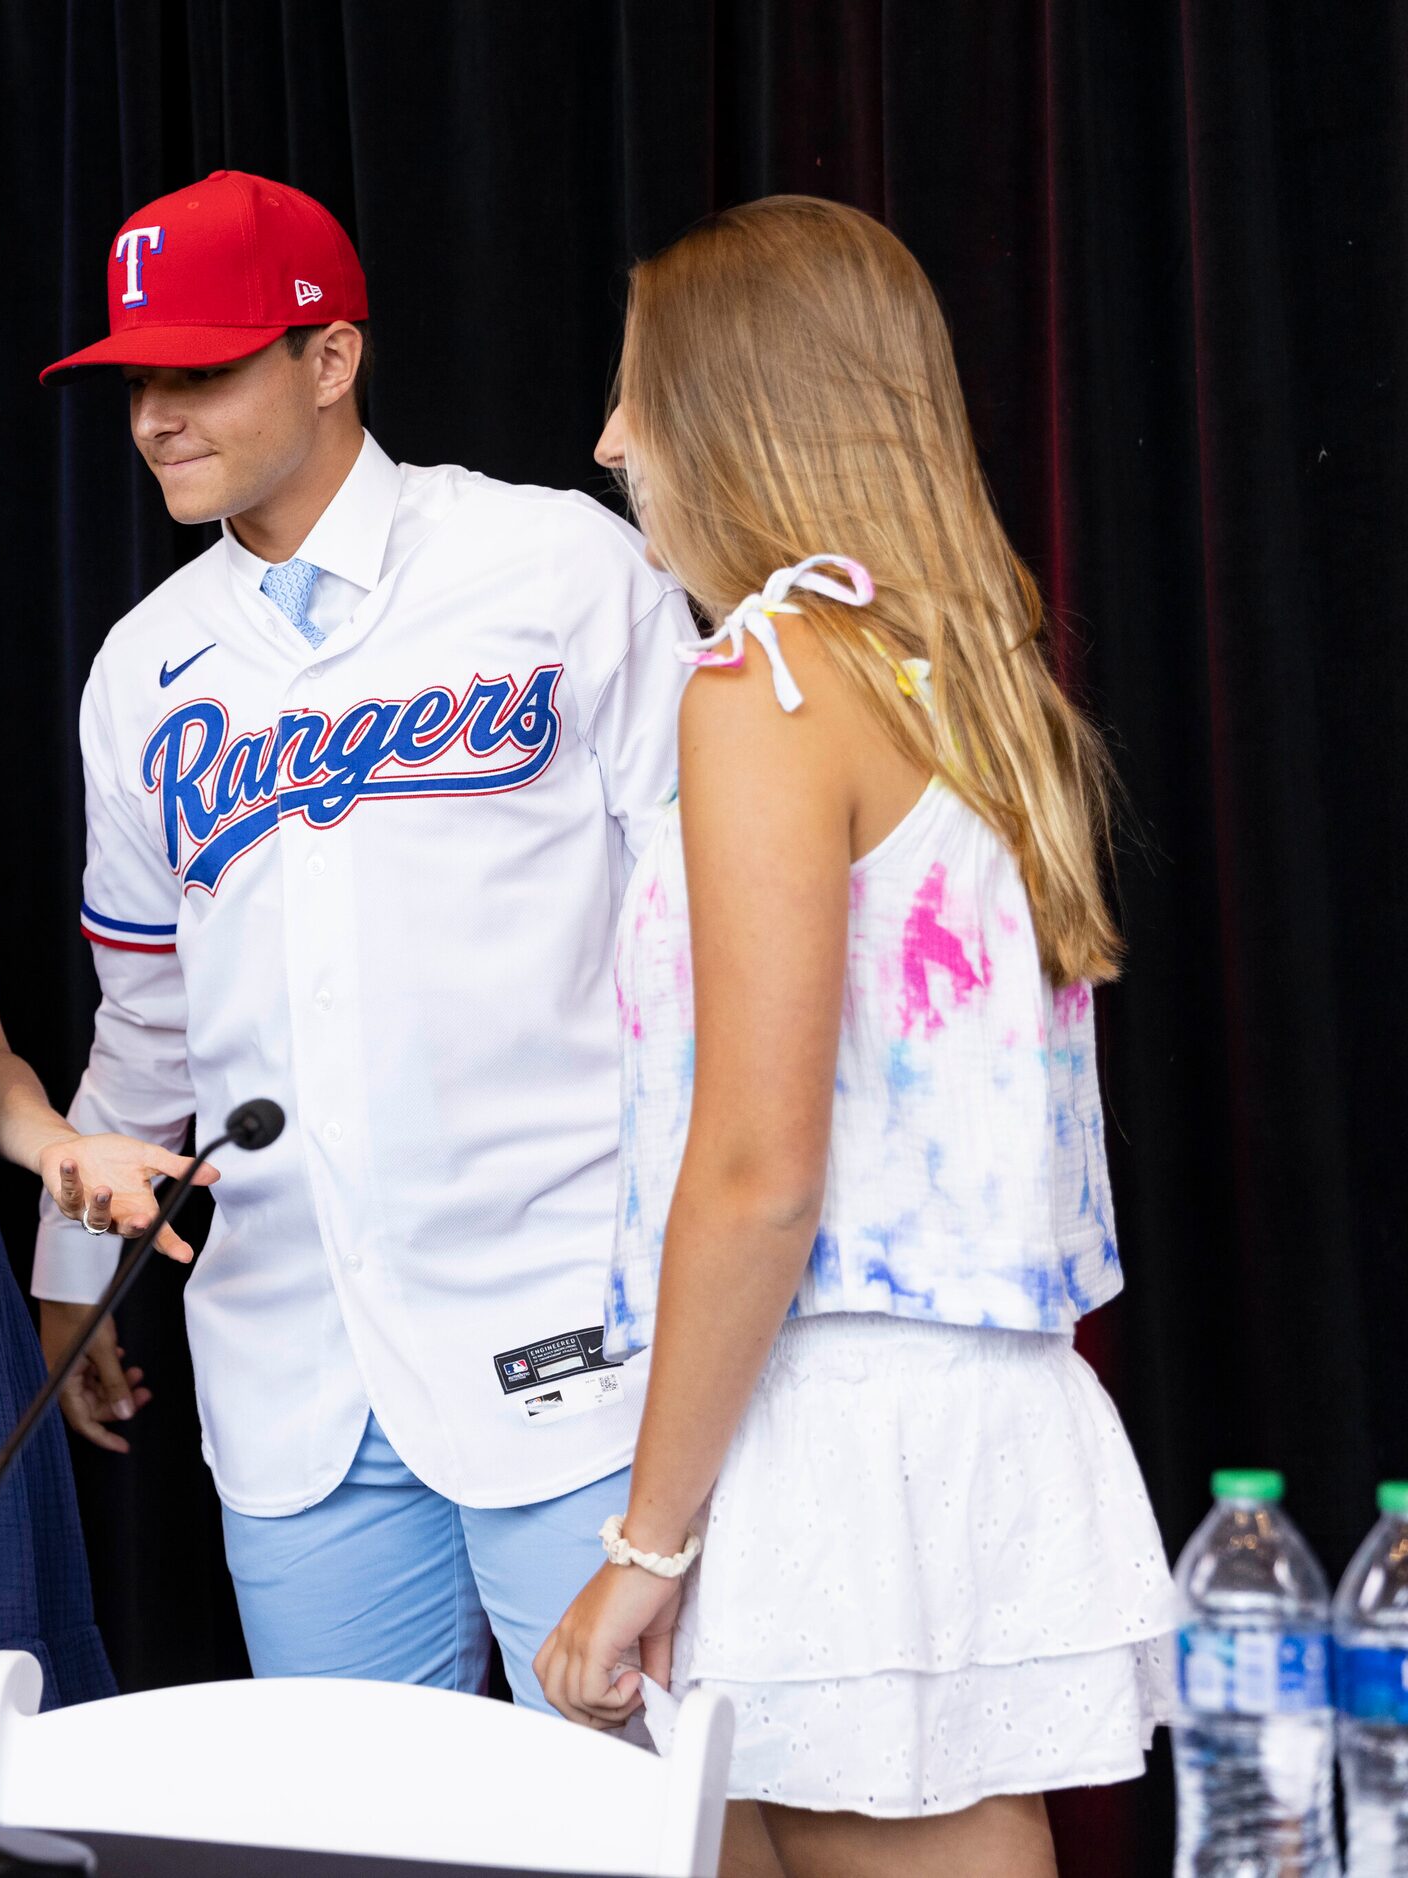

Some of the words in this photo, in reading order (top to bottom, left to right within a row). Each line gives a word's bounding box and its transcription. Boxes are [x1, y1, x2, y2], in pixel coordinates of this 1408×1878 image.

[115, 226, 165, 310] T
[140, 663, 564, 898] Rangers
[530, 1338, 576, 1356] ENGINEERED
